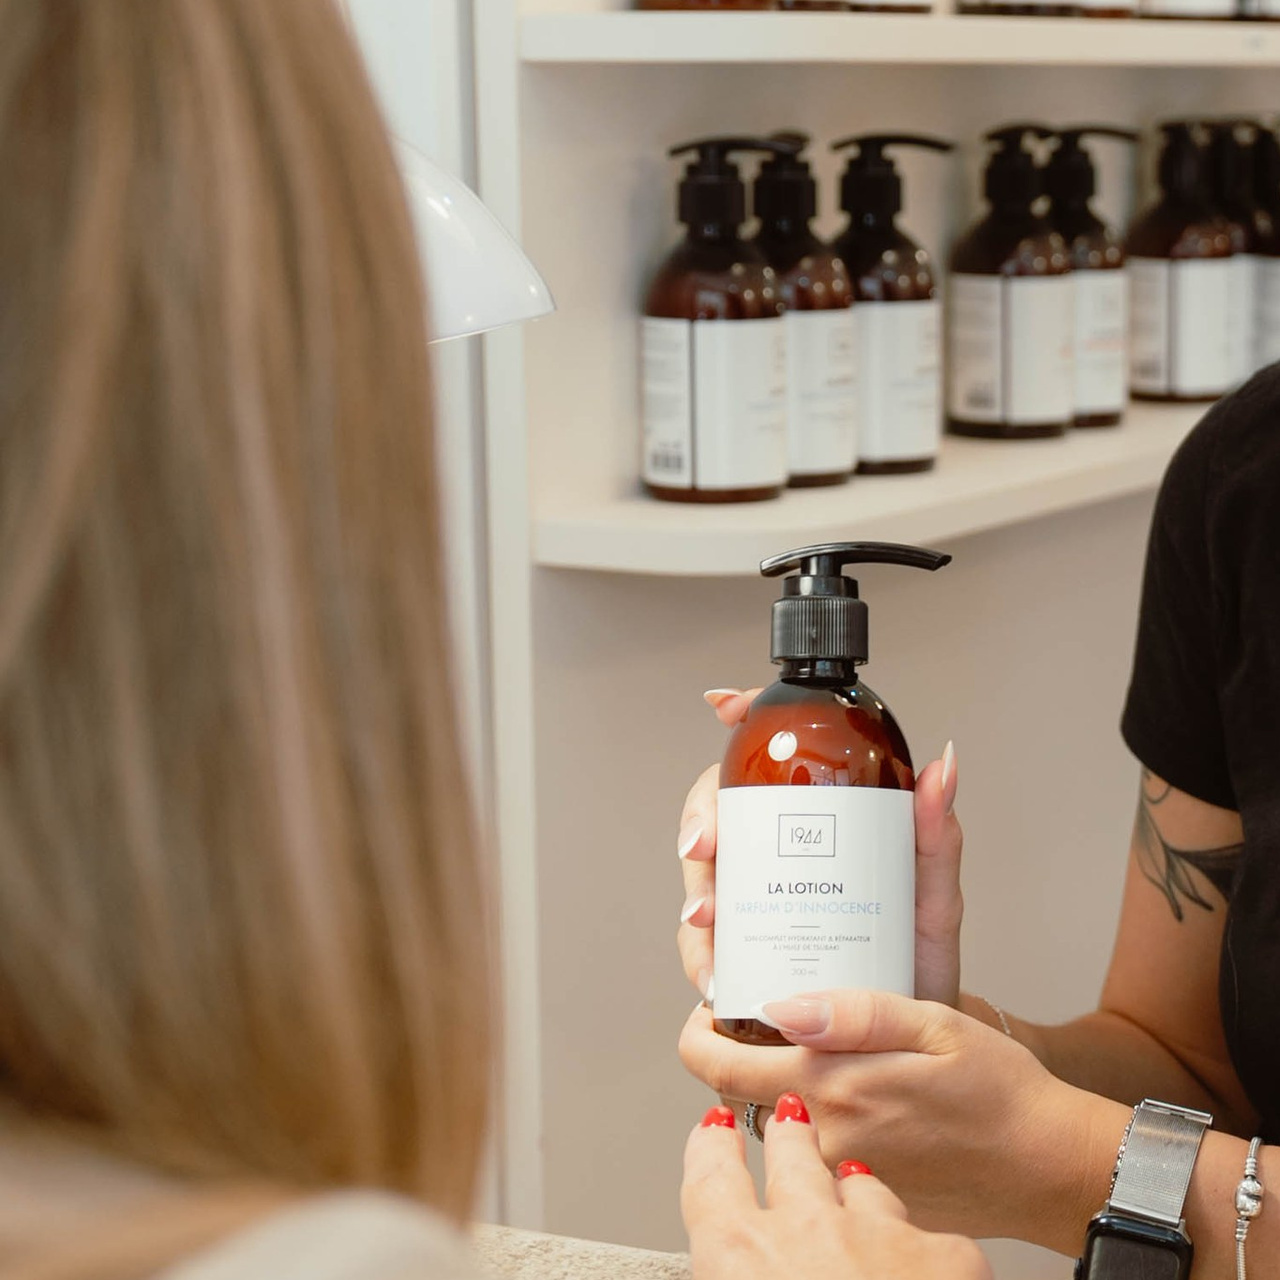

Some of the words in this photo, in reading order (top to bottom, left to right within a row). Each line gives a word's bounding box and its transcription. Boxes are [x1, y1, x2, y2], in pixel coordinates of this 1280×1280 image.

[768, 882, 784, 894] LA
[788, 882, 843, 895] LOTION
[735, 901, 780, 915] PARFUM
[784, 901, 881, 916] D'INNOCENCE
